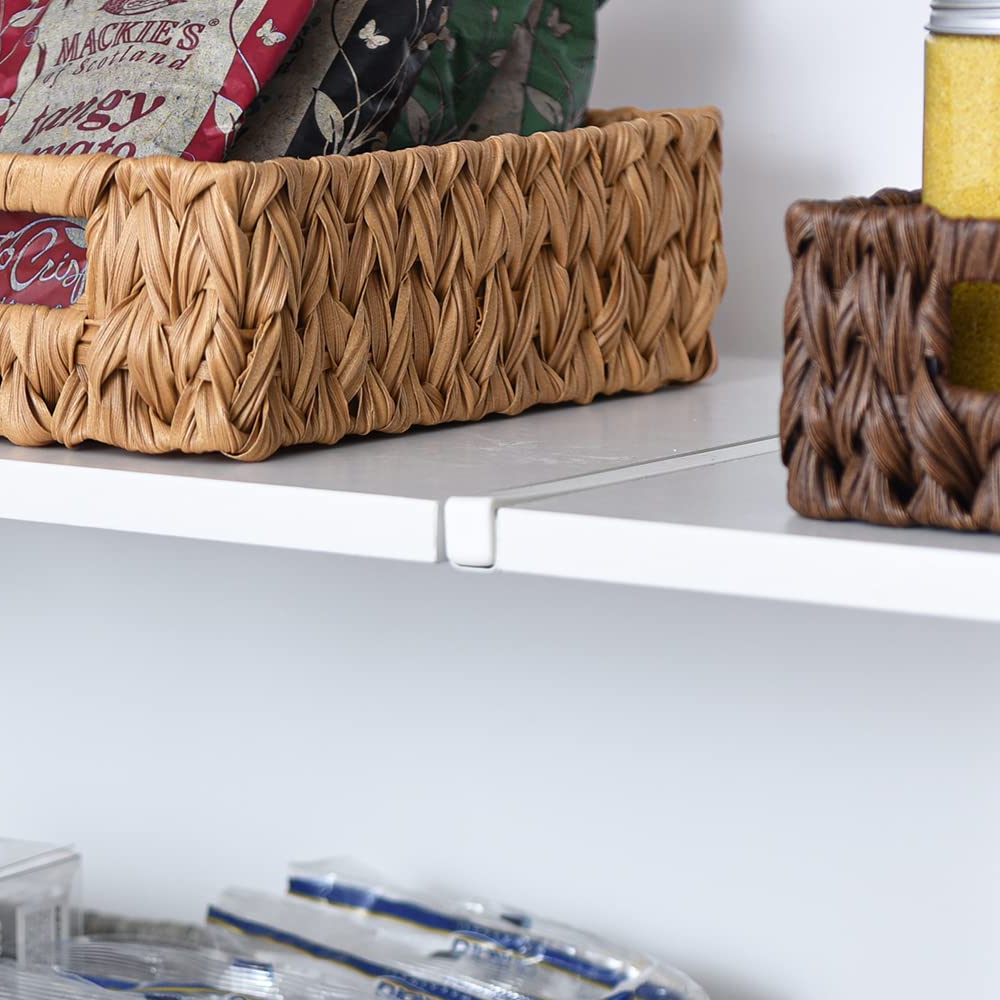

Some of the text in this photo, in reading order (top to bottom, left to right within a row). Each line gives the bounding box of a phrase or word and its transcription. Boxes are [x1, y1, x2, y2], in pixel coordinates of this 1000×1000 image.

[43, 45, 192, 88] of Scotland
[22, 89, 166, 144] tangy
